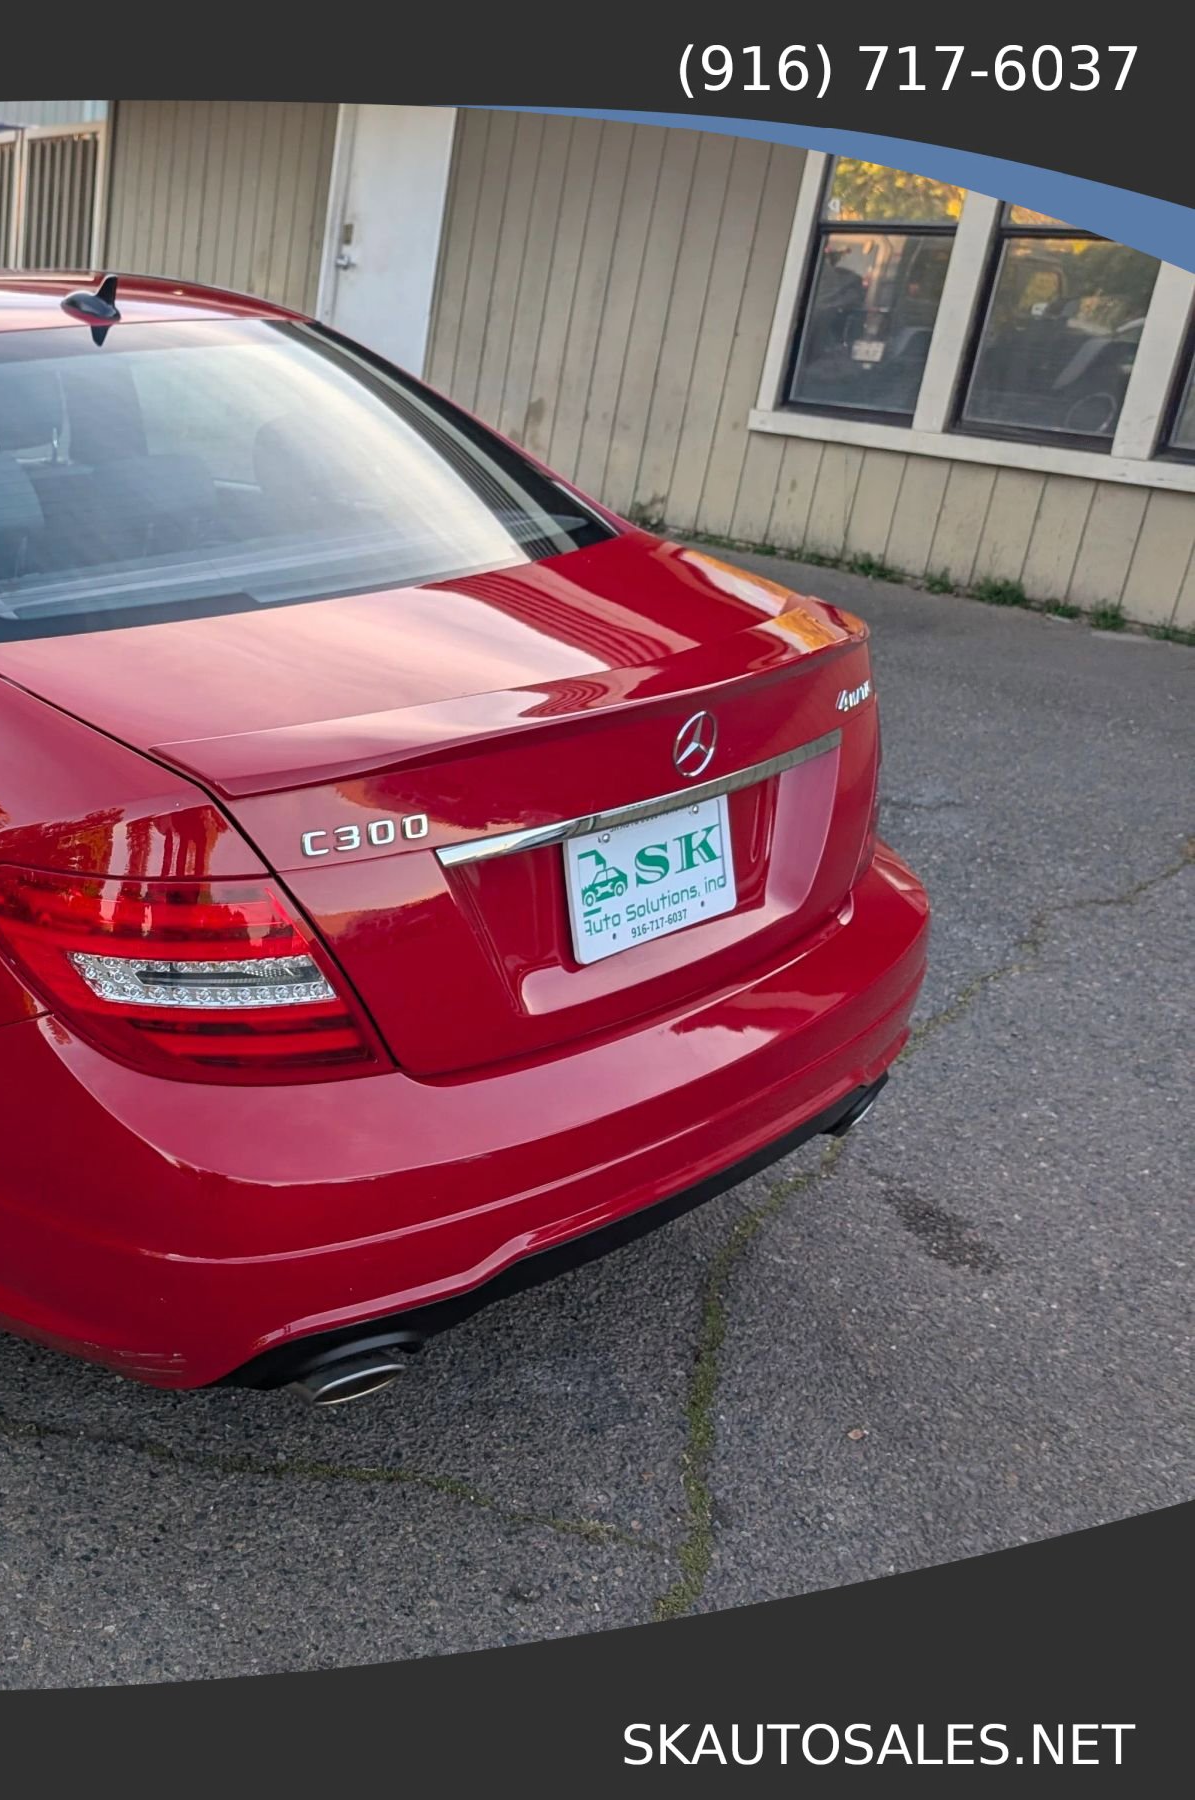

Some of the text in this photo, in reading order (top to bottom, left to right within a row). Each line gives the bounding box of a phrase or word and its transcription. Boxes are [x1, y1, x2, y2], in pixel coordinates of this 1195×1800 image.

[301, 813, 429, 857] C300
[634, 823, 723, 889] SK
[631, 908, 688, 938] 916-717-6037
